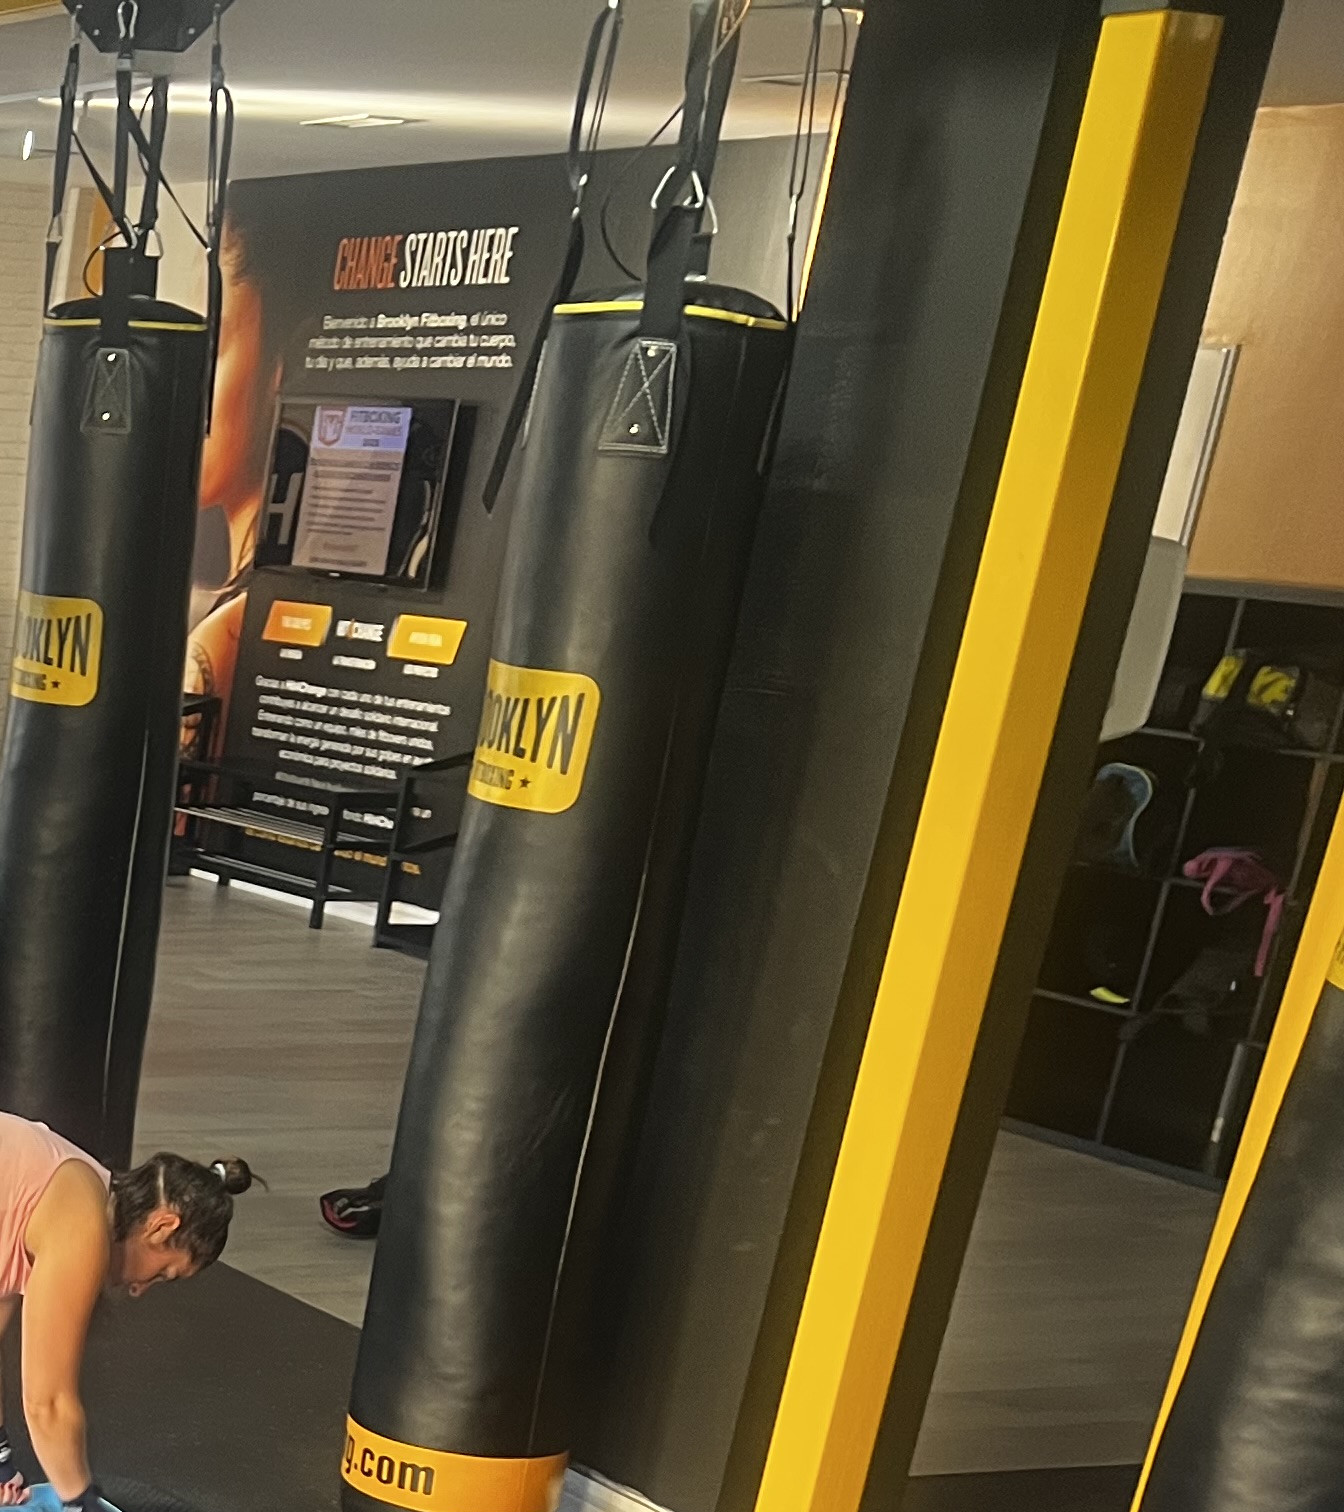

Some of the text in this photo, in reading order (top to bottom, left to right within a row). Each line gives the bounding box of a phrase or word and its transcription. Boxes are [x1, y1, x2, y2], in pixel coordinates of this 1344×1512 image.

[334, 226, 519, 290] CHANGE STARTS HERE
[376, 314, 419, 330] Brooklyn
